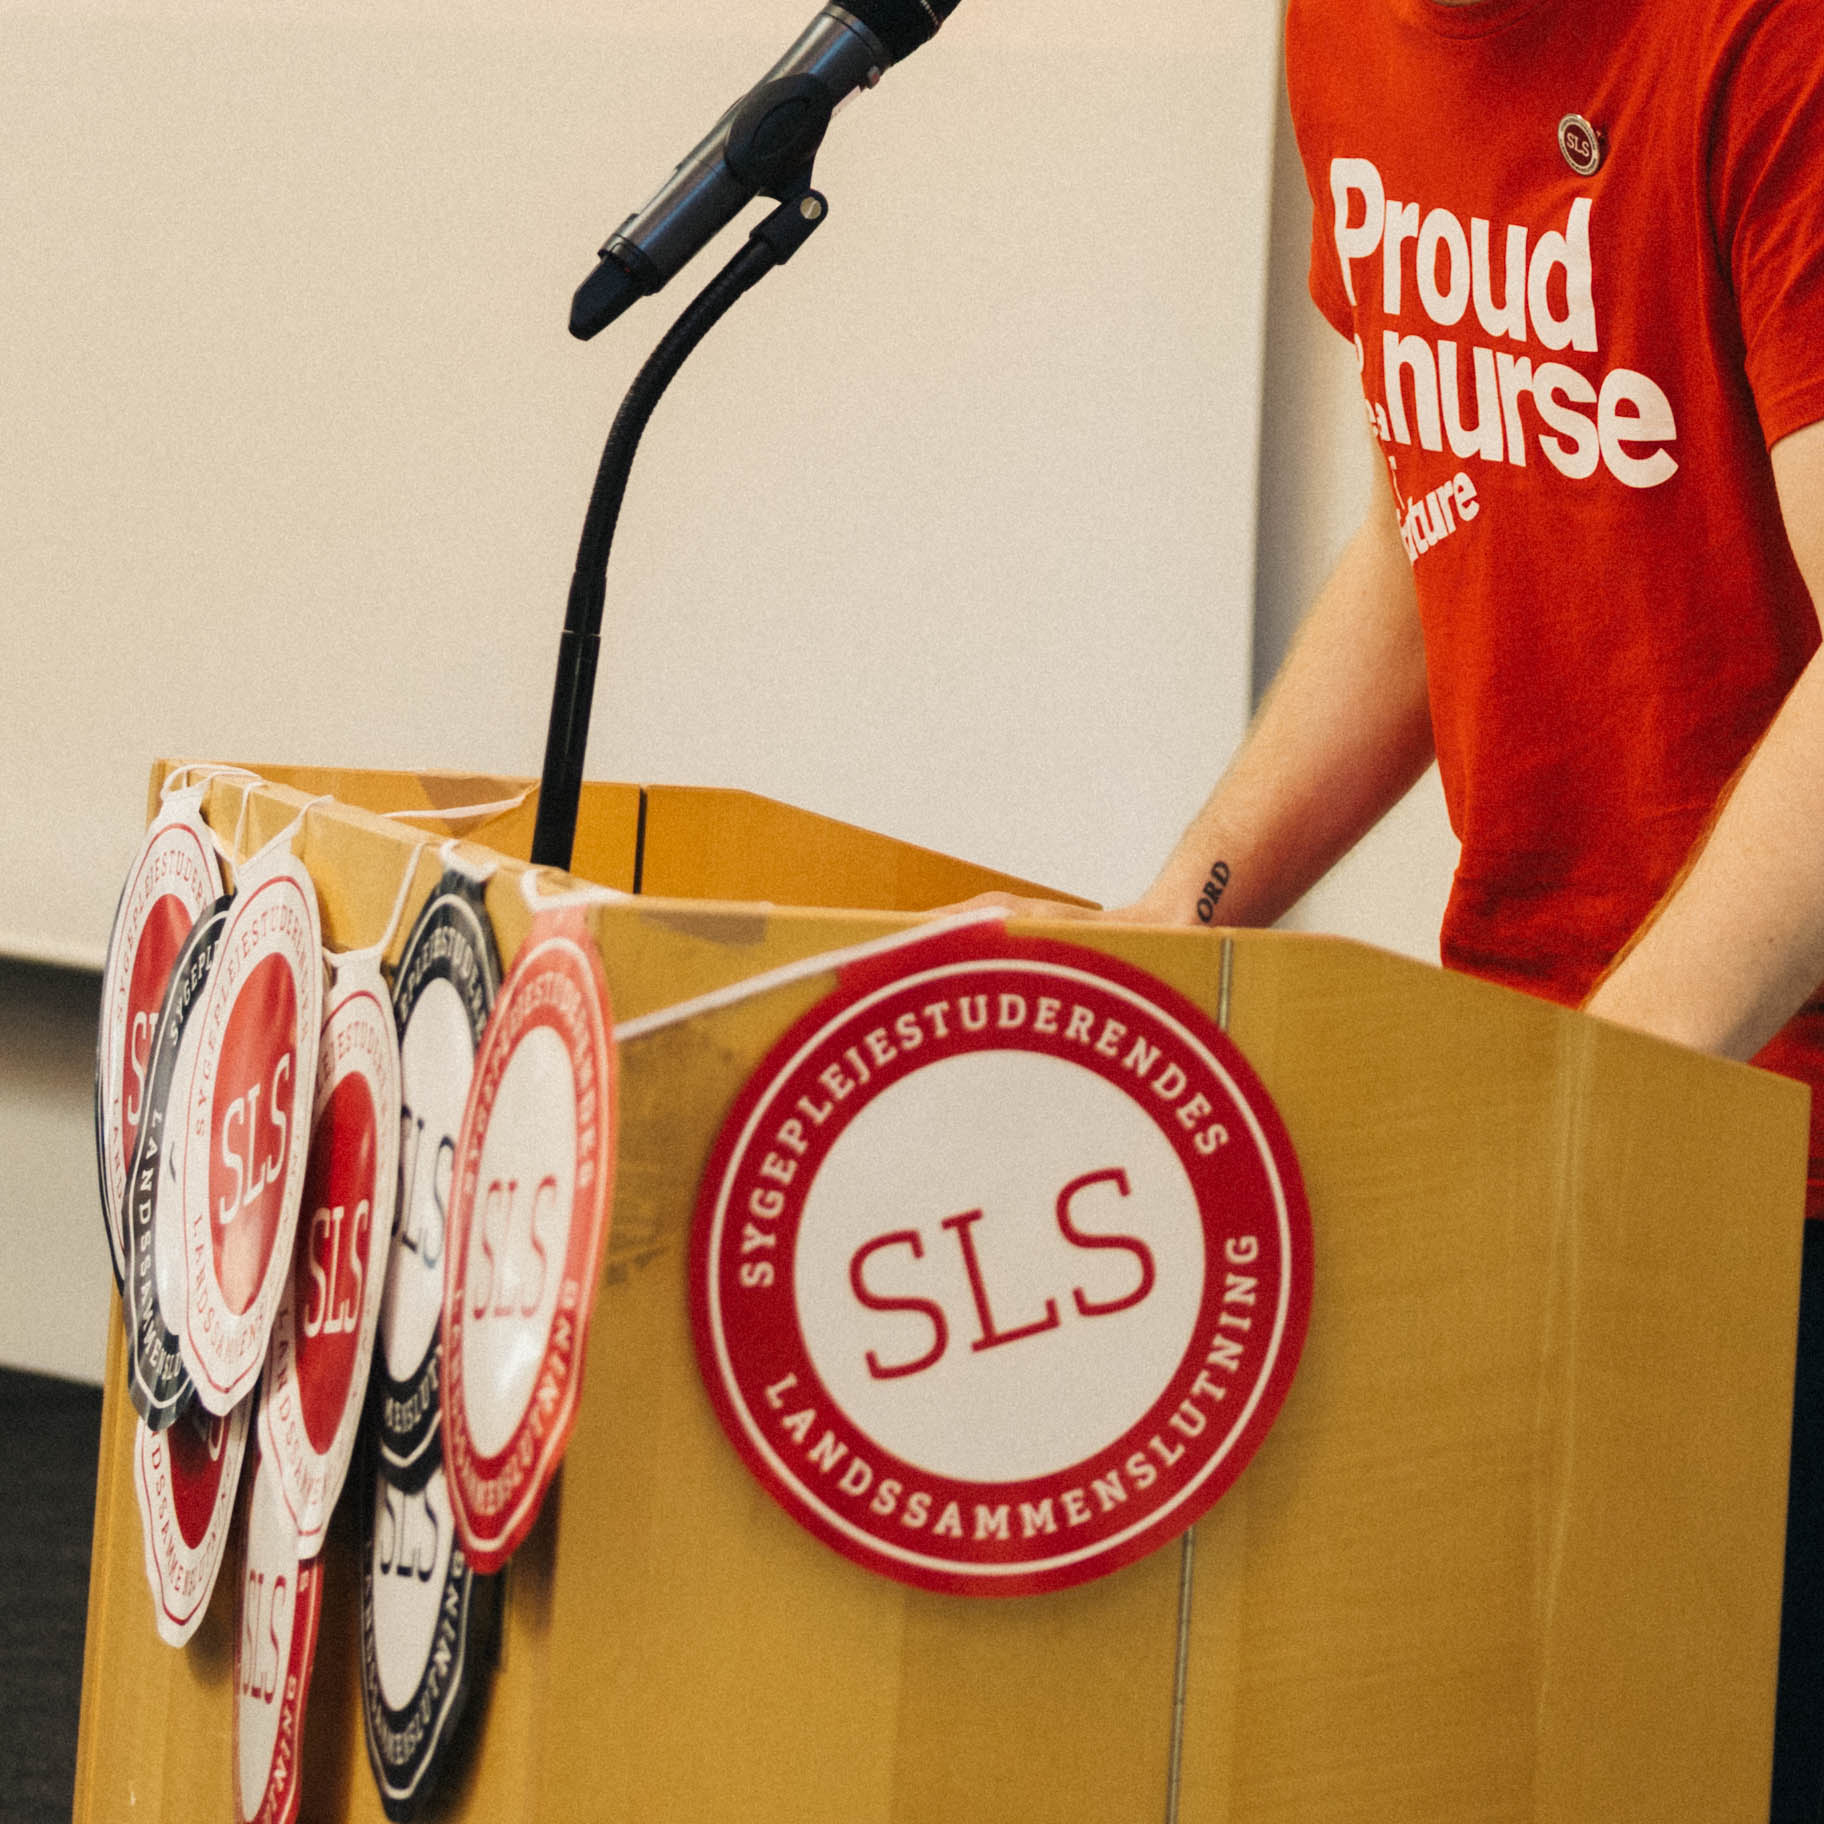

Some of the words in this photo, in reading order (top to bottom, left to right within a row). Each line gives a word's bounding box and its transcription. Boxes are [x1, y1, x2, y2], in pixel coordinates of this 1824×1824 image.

[1567, 132, 1590, 157] SLS
[1330, 157, 1598, 353] Proud
[1383, 330, 1679, 489] nurse
[219, 1052, 290, 1224] SLS
[741, 993, 1229, 1288] SYGEPLEJESTUDERENDES
[304, 1199, 369, 1338] SLS
[473, 1174, 557, 1320] SLS
[848, 1166, 1156, 1380] SLS
[765, 1233, 1259, 1540] LANDSSAMMENSLUTNING
